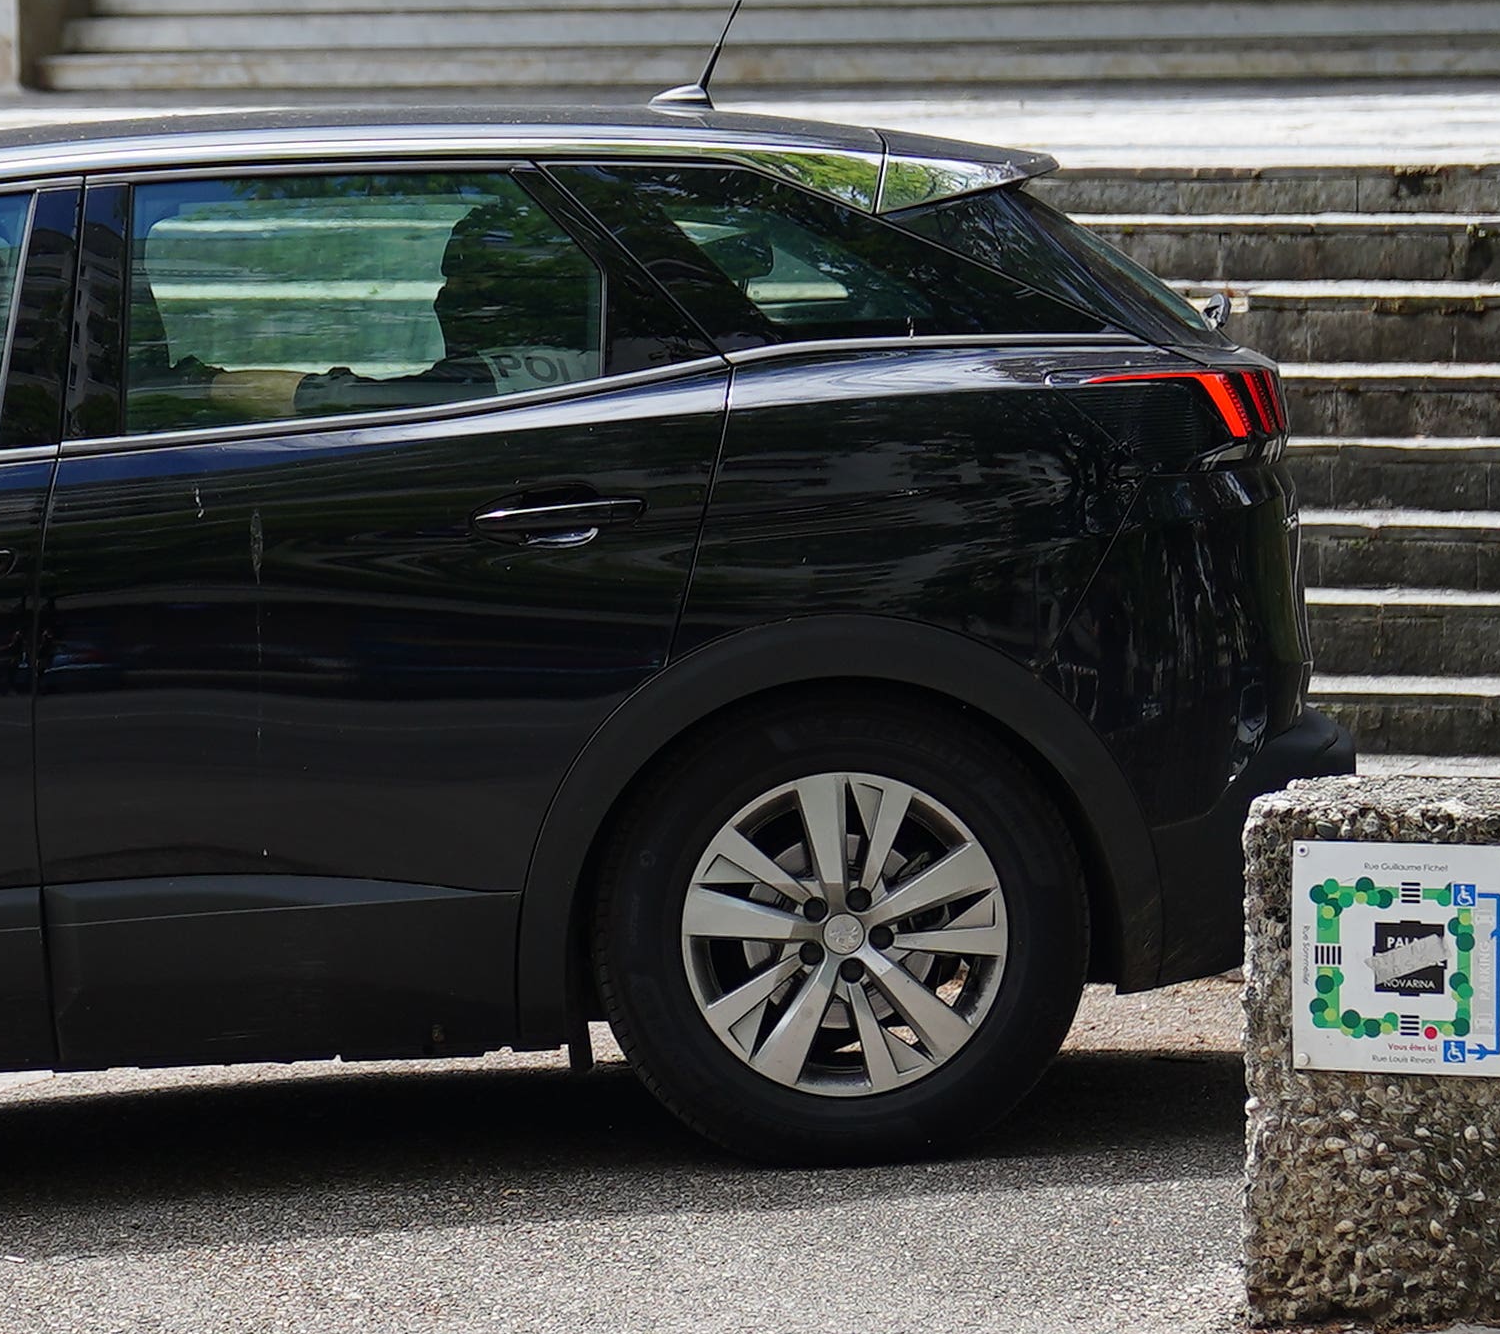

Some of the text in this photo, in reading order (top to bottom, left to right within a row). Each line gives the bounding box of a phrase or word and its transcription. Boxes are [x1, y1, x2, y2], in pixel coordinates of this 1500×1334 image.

[1364, 862, 1379, 870] Rue
[1387, 937, 1419, 948] PAL
[1480, 941, 1491, 1001] PARKING
[1389, 1055, 1408, 1063] Louis
